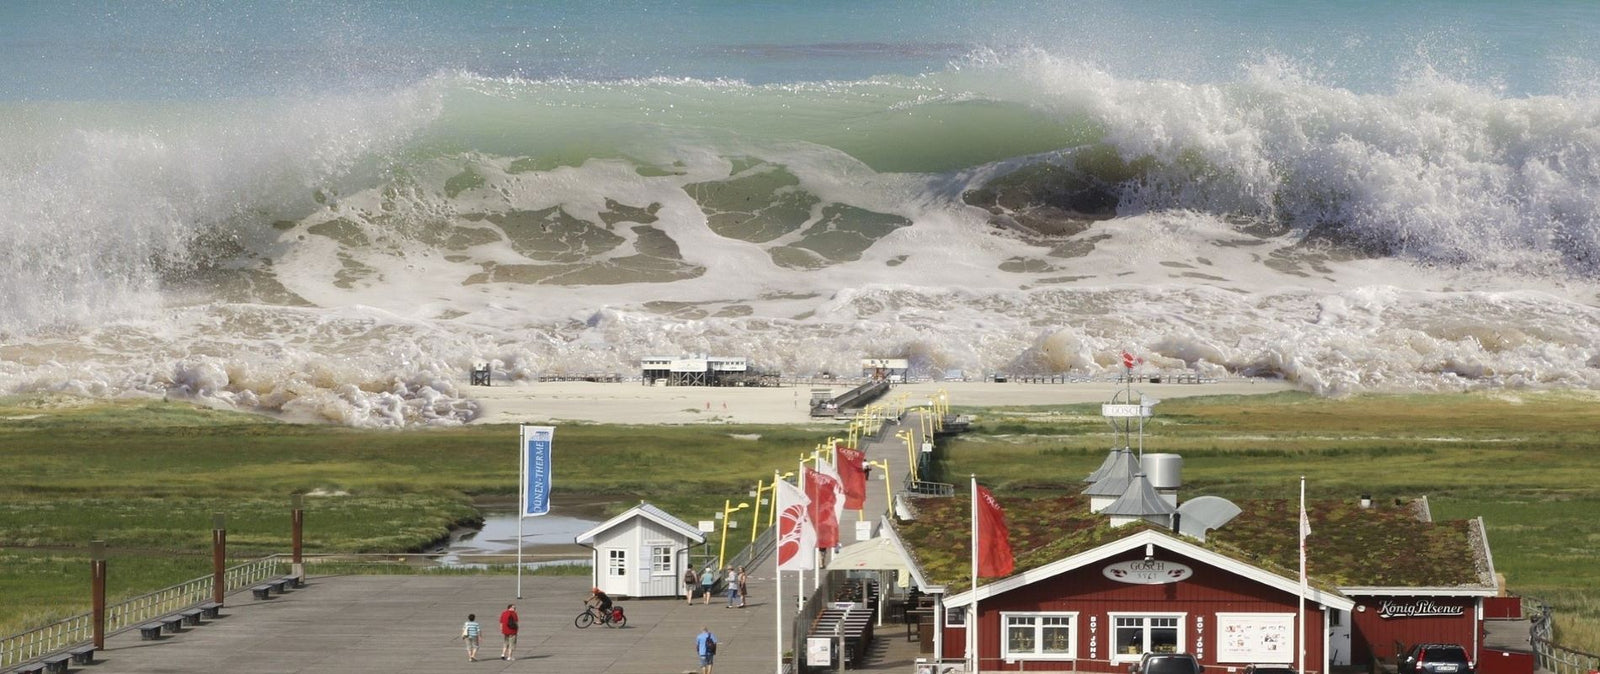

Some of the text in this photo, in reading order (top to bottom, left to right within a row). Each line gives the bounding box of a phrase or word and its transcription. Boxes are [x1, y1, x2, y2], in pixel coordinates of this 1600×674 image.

[1130, 562, 1165, 571] GOSCH
[1377, 600, 1463, 616] König Pilsener
[1196, 616, 1204, 634] BOY
